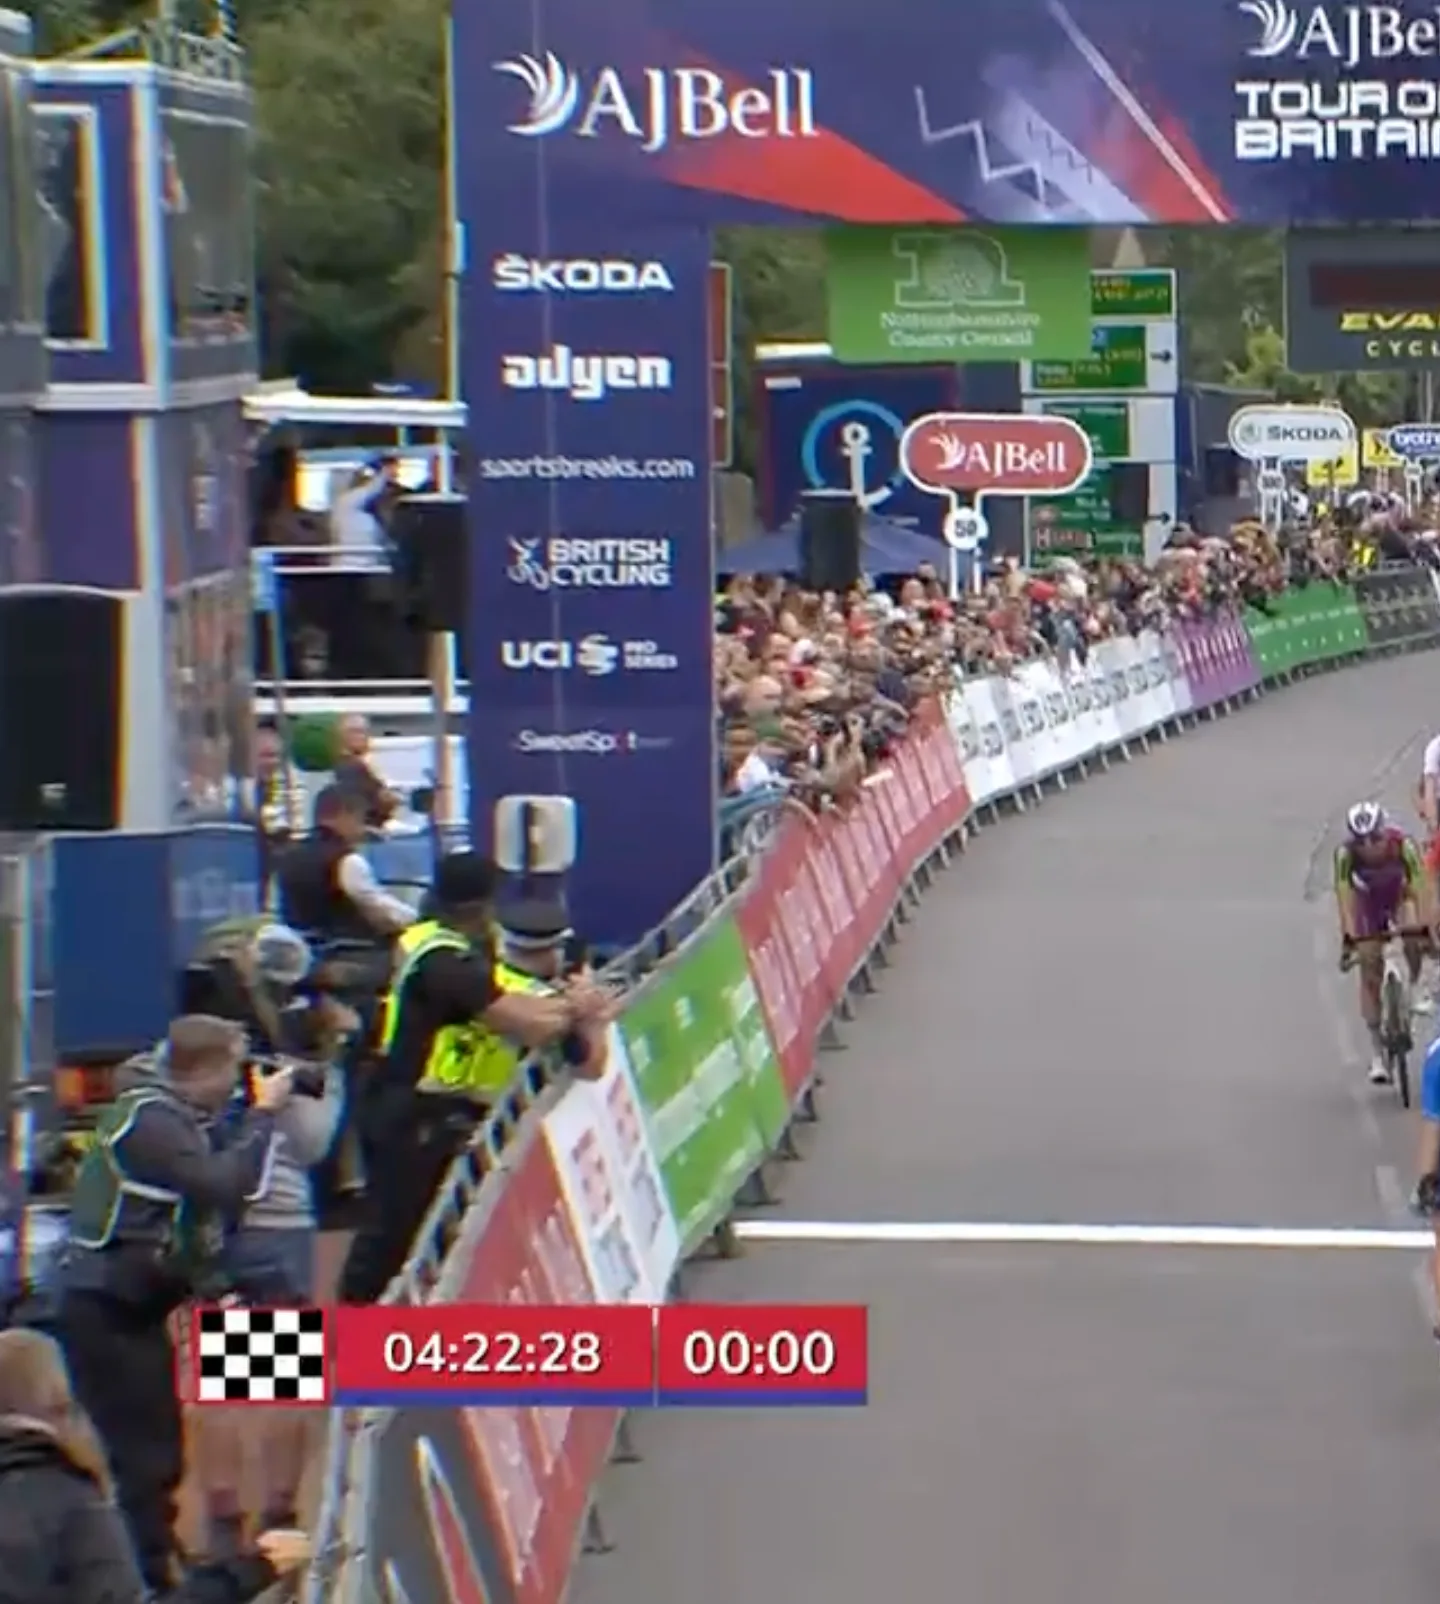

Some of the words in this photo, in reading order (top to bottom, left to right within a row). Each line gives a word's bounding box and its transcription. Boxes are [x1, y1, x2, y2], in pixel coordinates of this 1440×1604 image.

[1235, 81, 1386, 118] TOUR
[492, 251, 674, 292] ŠKODA
[503, 342, 671, 399] adyen
[481, 453, 695, 481] sportsbreaks.com
[963, 440, 1068, 478] AJBell
[954, 519, 977, 538] 50
[549, 538, 671, 562] BRITISH
[550, 563, 672, 586] CYCLING
[502, 640, 571, 668] UCI
